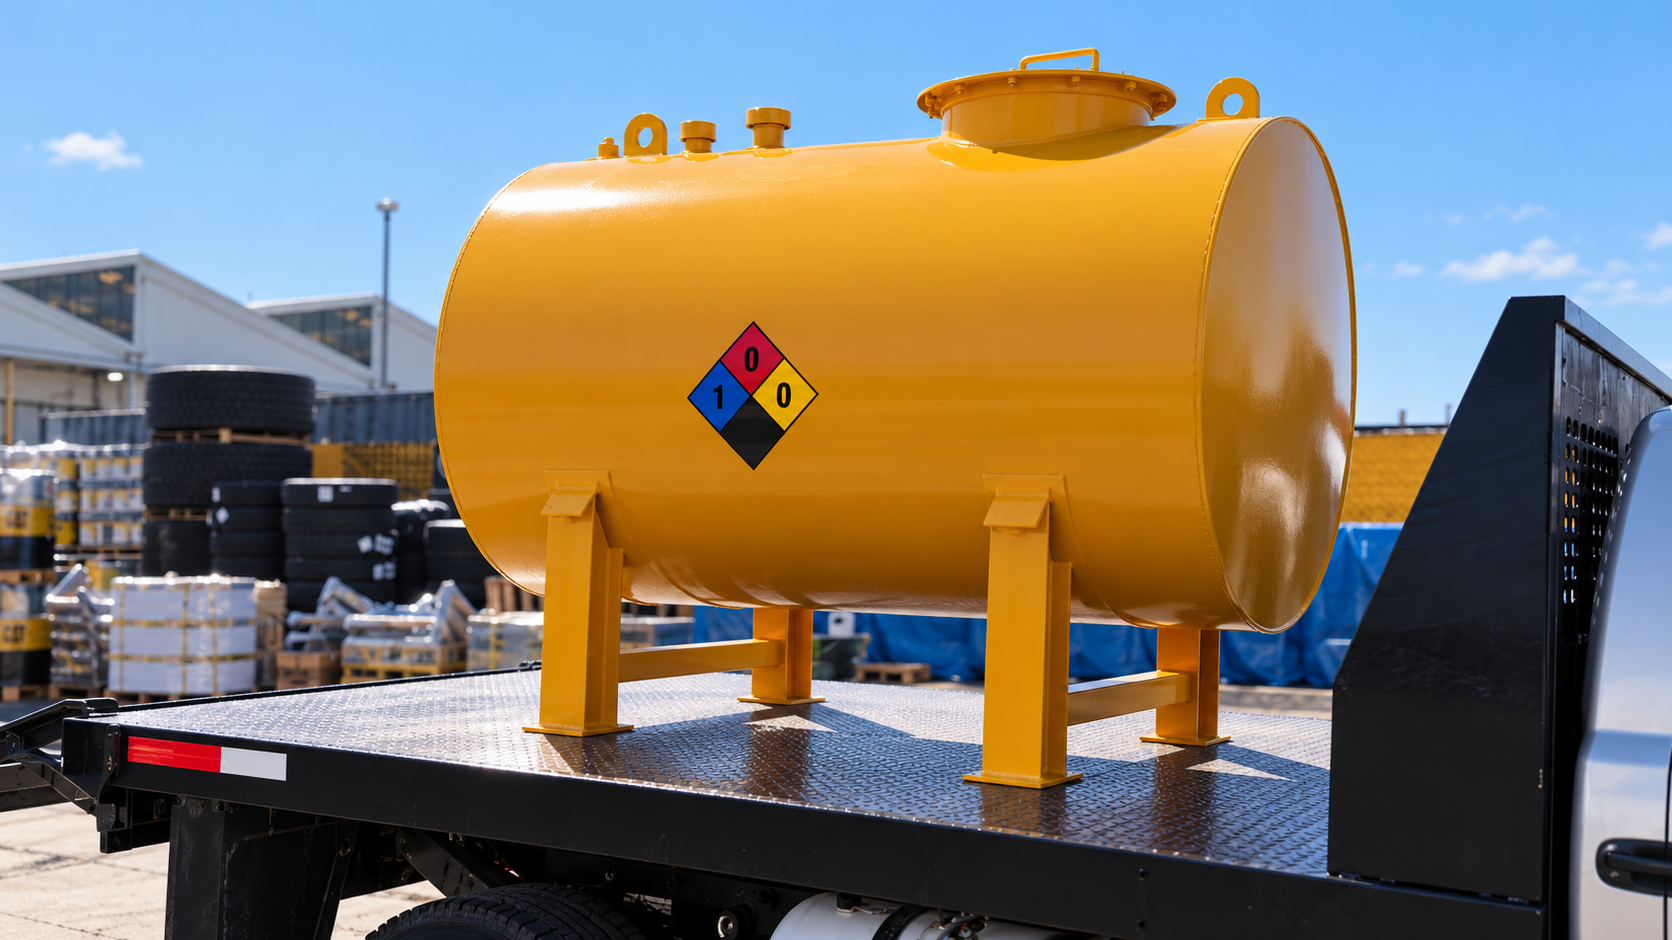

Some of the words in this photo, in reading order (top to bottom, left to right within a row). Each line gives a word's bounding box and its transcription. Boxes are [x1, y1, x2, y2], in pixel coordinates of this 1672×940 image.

[745, 347, 759, 372] 0
[713, 384, 723, 409] 1
[777, 382, 791, 408] 0
